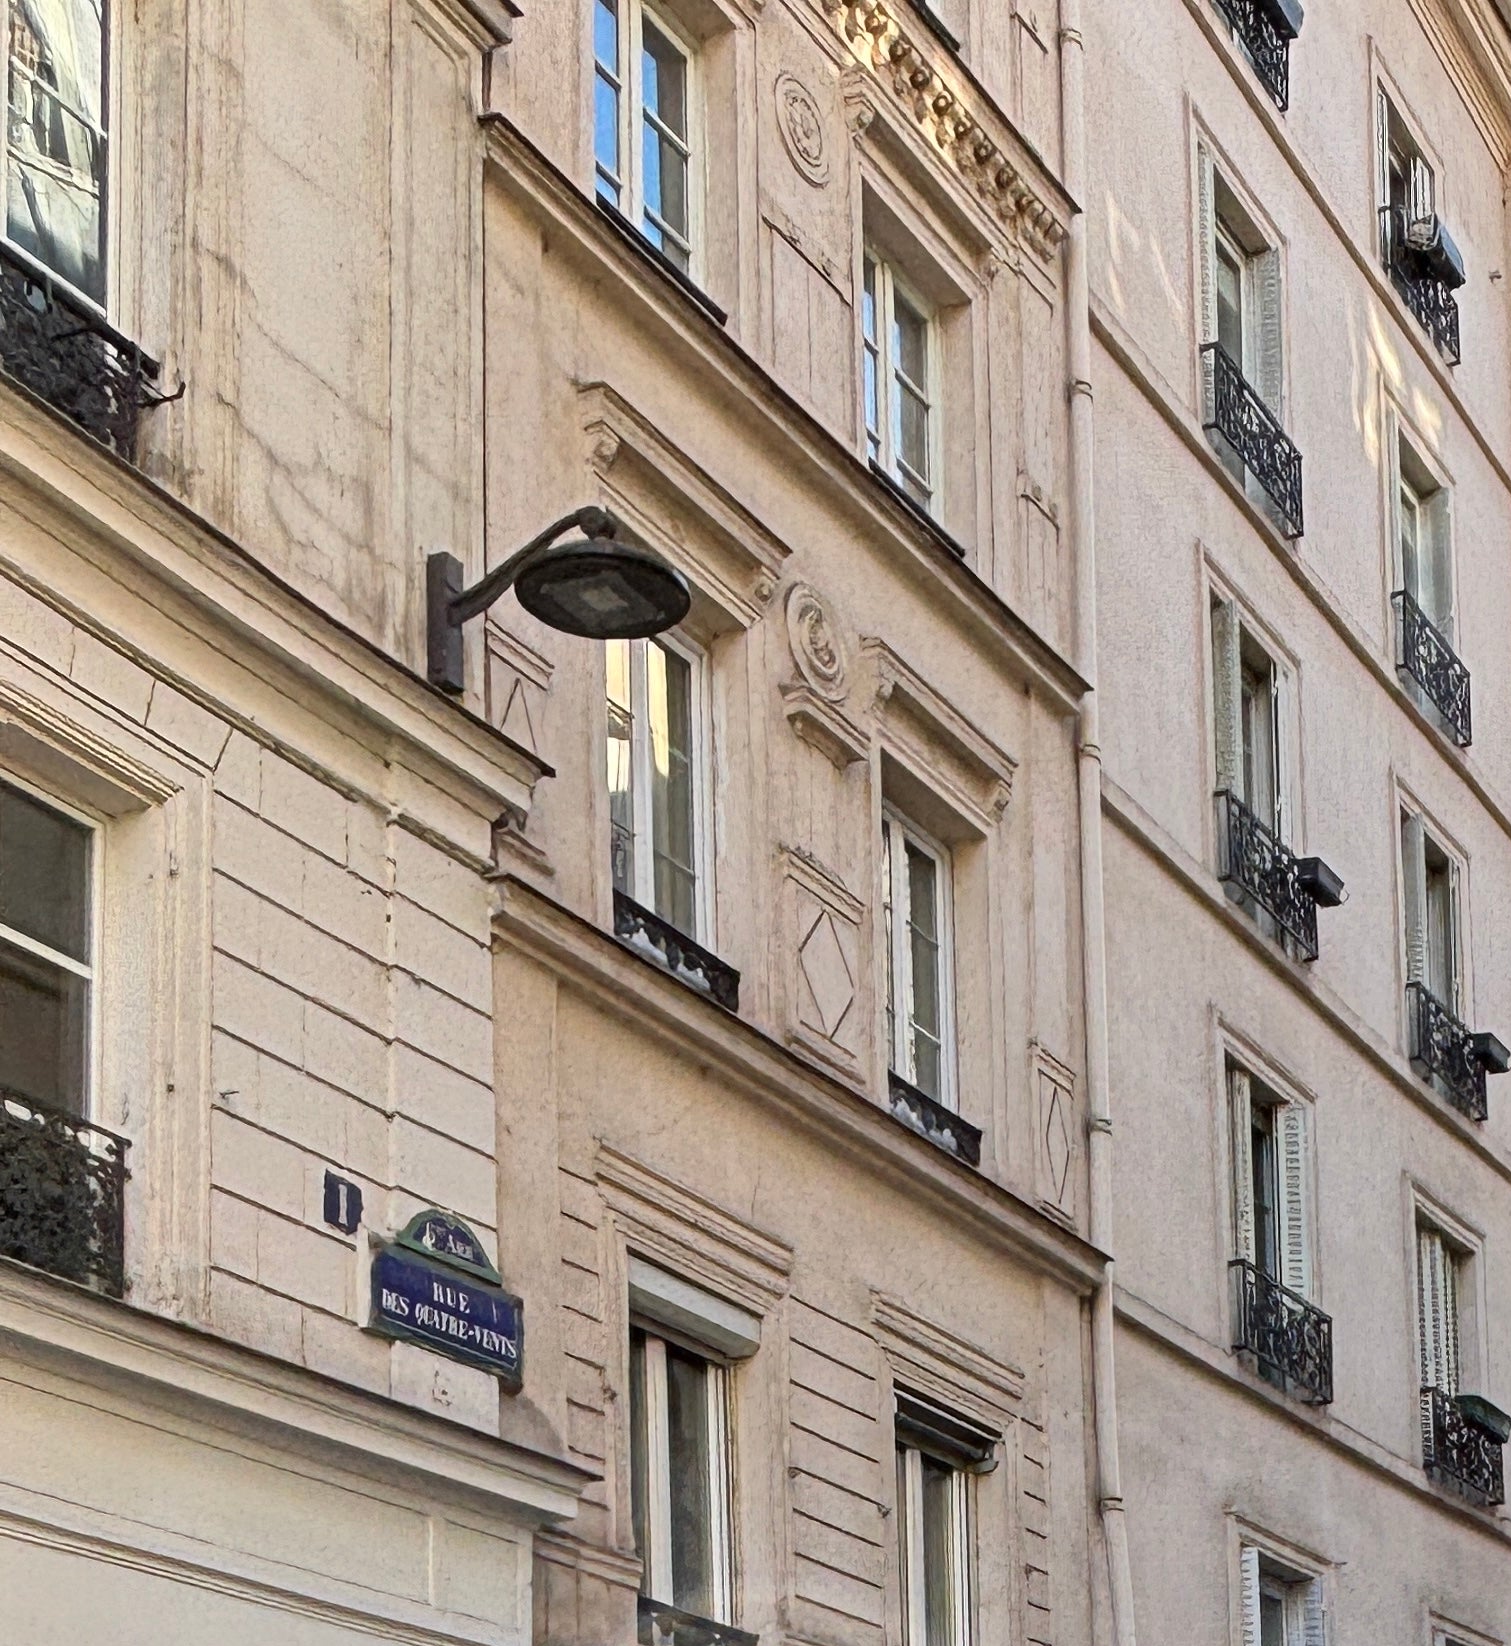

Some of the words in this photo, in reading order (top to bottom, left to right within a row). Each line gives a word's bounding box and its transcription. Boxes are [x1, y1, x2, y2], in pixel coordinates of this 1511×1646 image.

[381, 1287, 411, 1317] DES
[414, 1302, 517, 1360] QUATRE-VENTS
[432, 1281, 471, 1315] RUE
